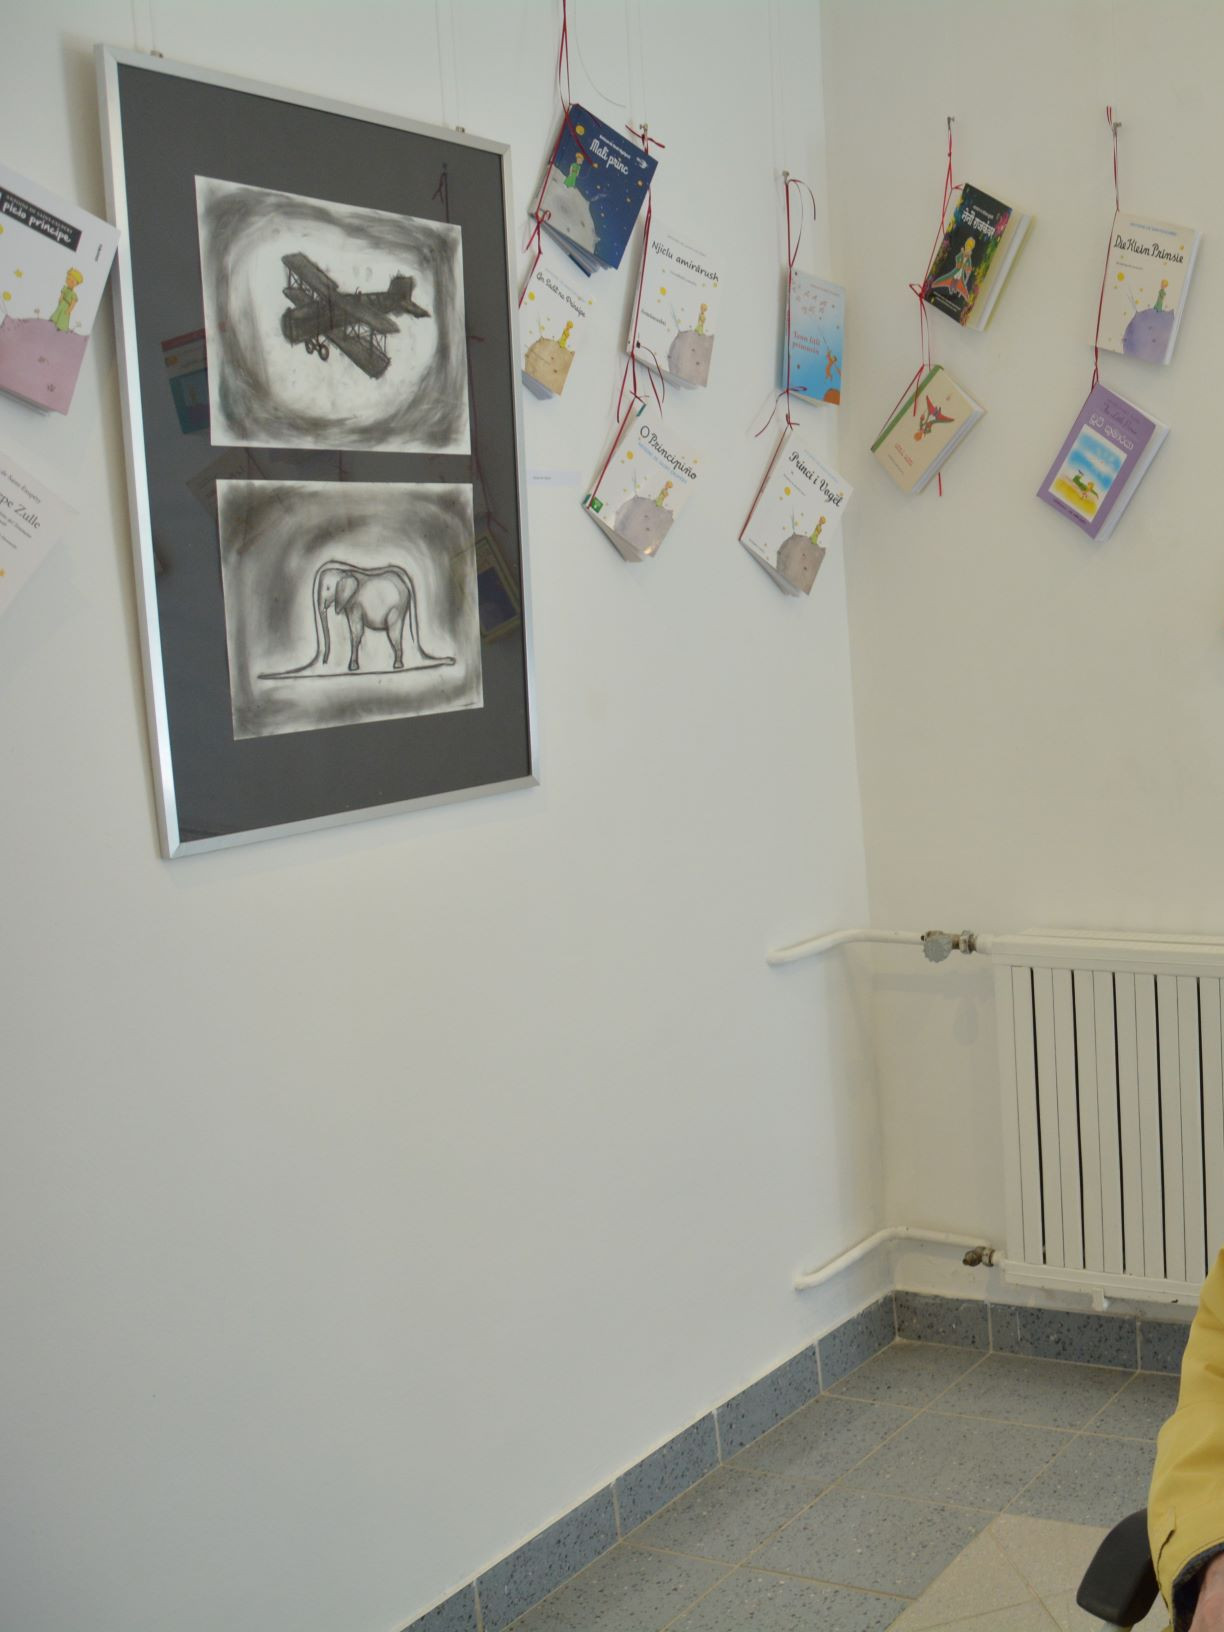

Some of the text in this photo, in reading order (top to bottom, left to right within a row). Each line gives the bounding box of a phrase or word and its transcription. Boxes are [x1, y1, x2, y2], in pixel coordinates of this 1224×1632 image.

[589, 138, 609, 160] Mali
[28, 215, 71, 243] principe
[639, 425, 650, 439] O
